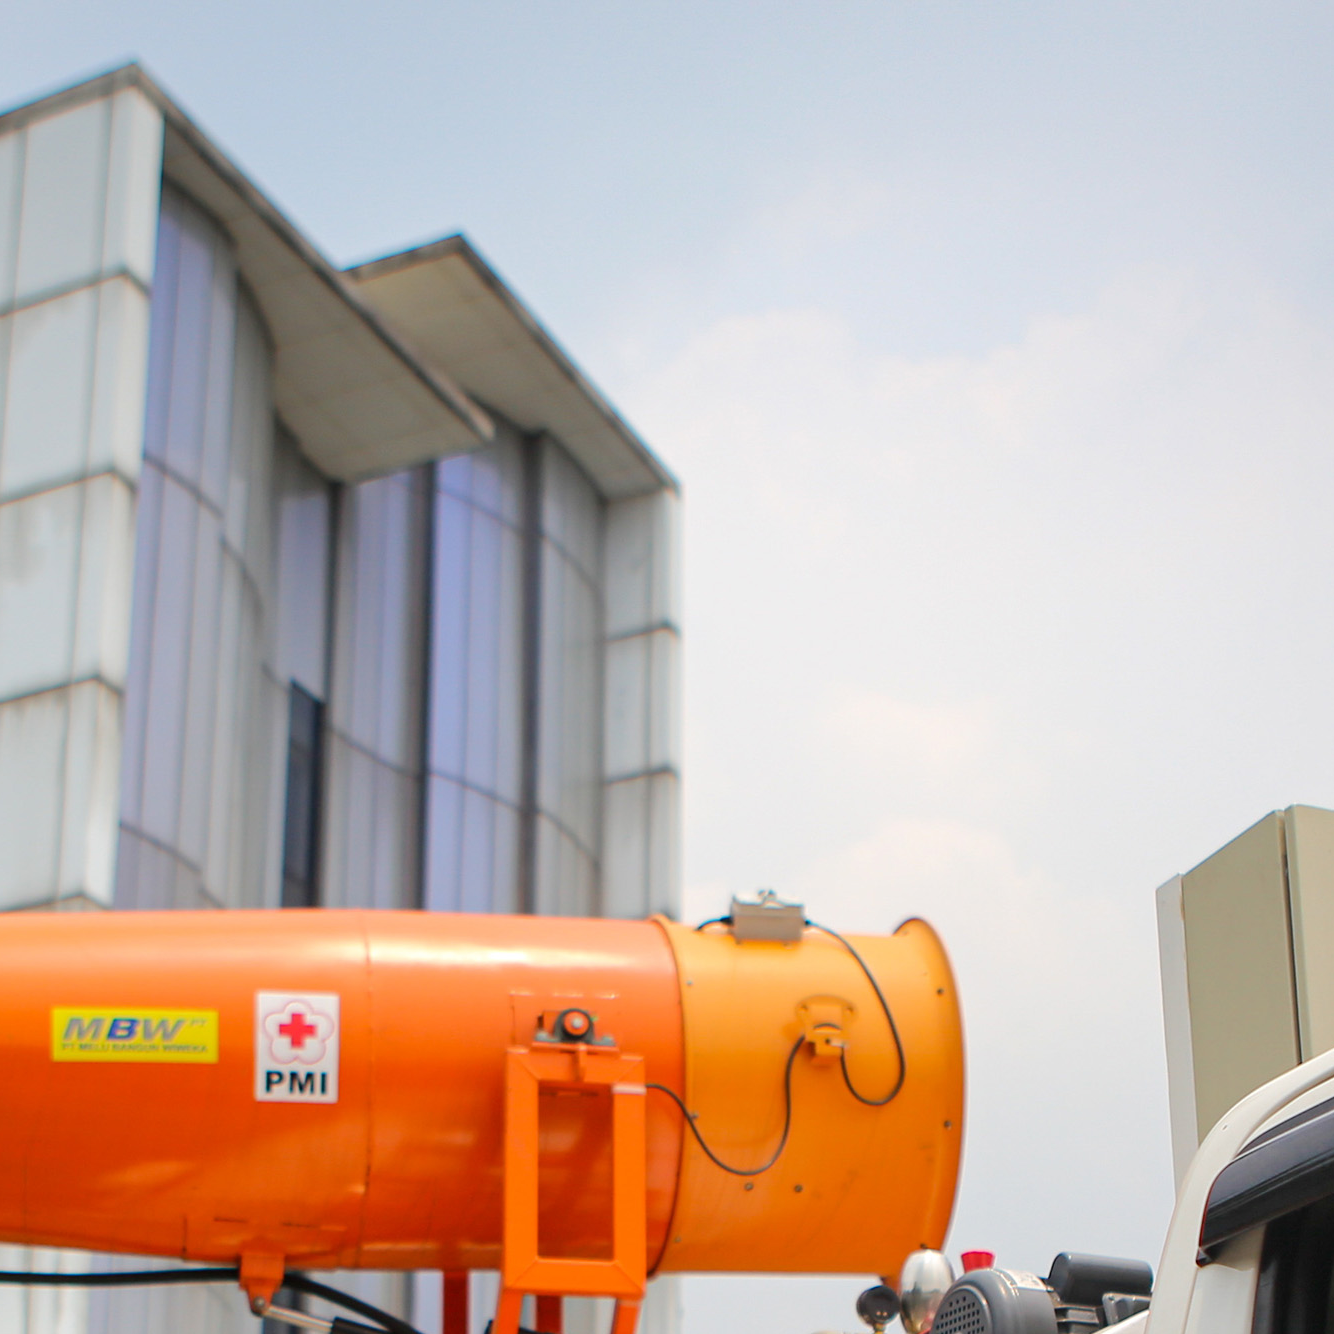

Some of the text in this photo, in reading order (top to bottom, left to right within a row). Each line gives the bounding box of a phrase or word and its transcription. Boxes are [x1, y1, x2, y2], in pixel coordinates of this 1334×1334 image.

[63, 1017, 186, 1040] MBW
[62, 1043, 75, 1051] PT
[265, 1069, 328, 1094] PMI
